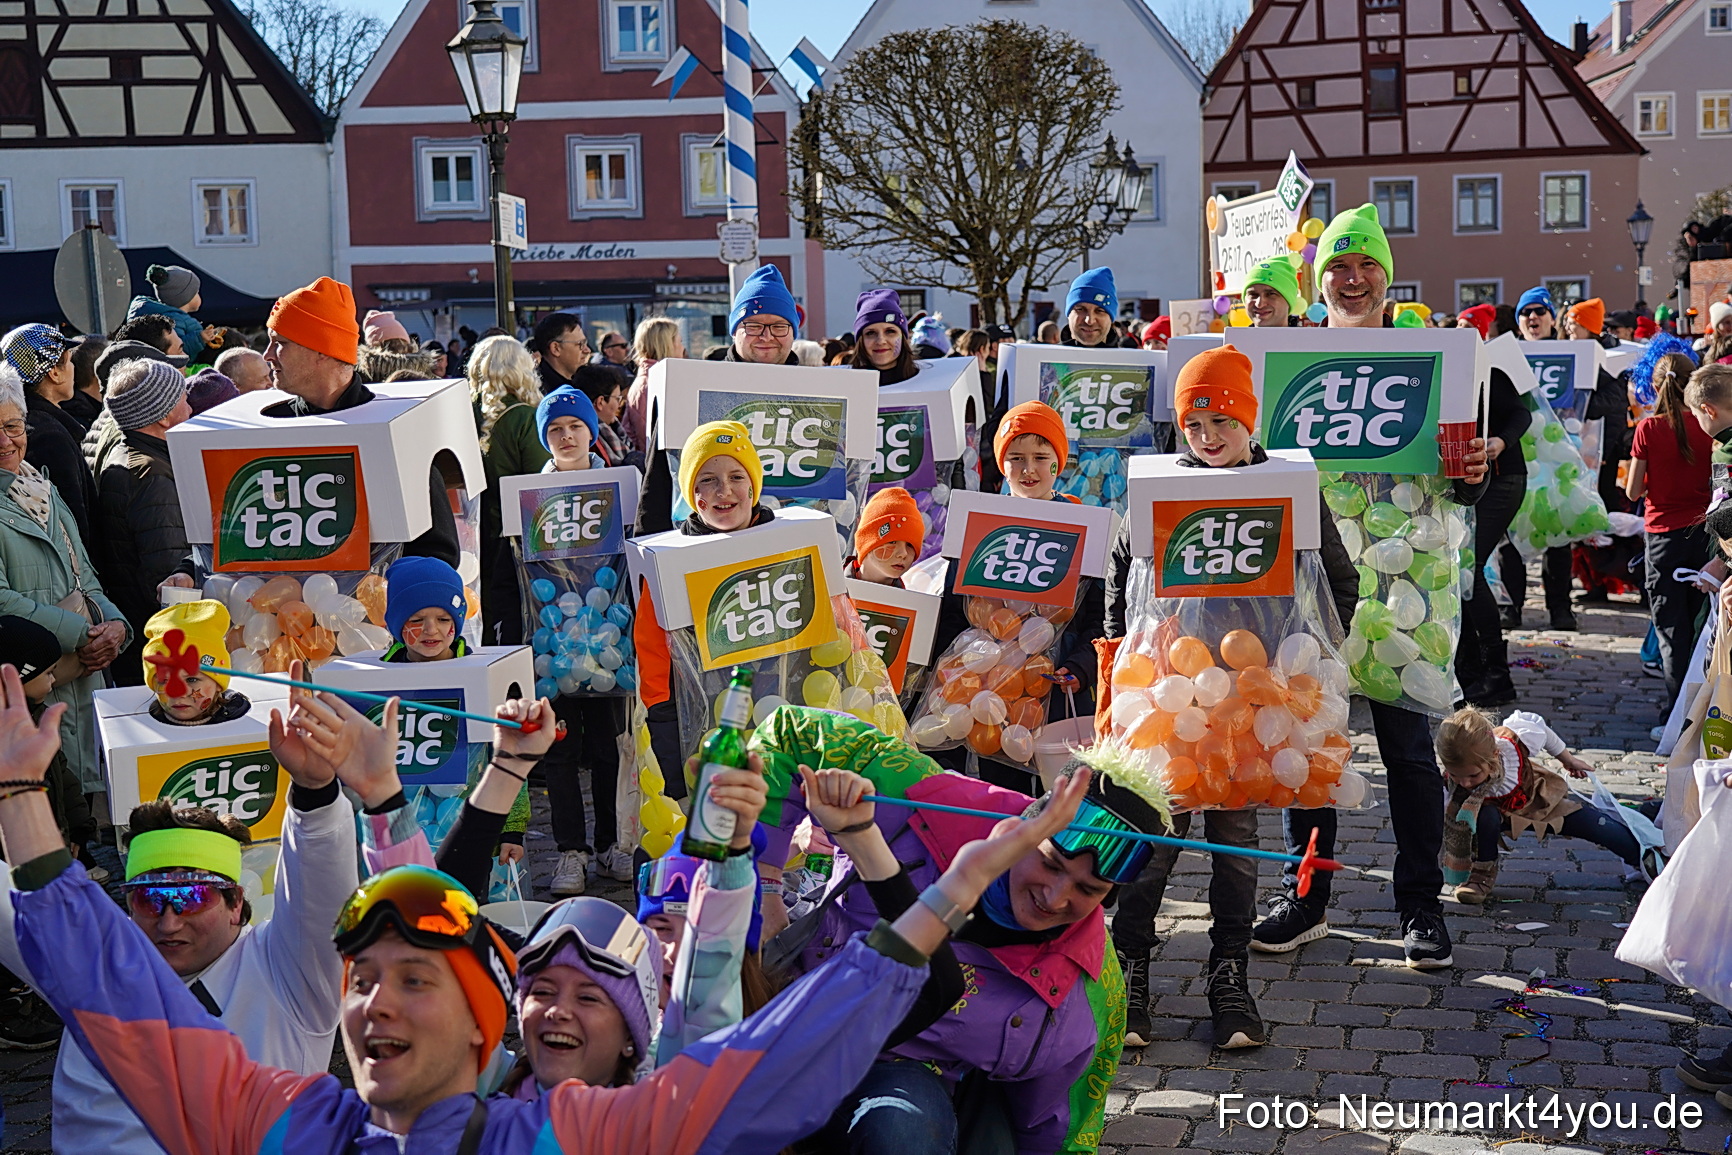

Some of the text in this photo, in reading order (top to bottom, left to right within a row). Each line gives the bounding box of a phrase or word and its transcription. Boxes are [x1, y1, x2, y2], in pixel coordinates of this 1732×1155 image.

[571, 243, 636, 260] Moden
[1321, 365, 1409, 410] tic
[1532, 361, 1561, 382] ic
[1078, 374, 1136, 405] tic
[749, 408, 823, 447] tic
[1060, 401, 1131, 430] tac
[1293, 407, 1404, 446] tac
[876, 418, 910, 448] ic
[761, 448, 818, 478] ac
[869, 448, 910, 474] ac
[257, 463, 337, 510] tic
[554, 495, 602, 522] tic
[240, 507, 337, 548] tac
[542, 520, 601, 543] tac
[1200, 513, 1266, 548] tic
[1004, 532, 1061, 565] tic
[1181, 545, 1262, 575] tac
[983, 554, 1055, 587] tac
[735, 571, 799, 611] tic
[722, 601, 802, 642] tac
[395, 739, 442, 766] ac
[191, 761, 261, 798] tic
